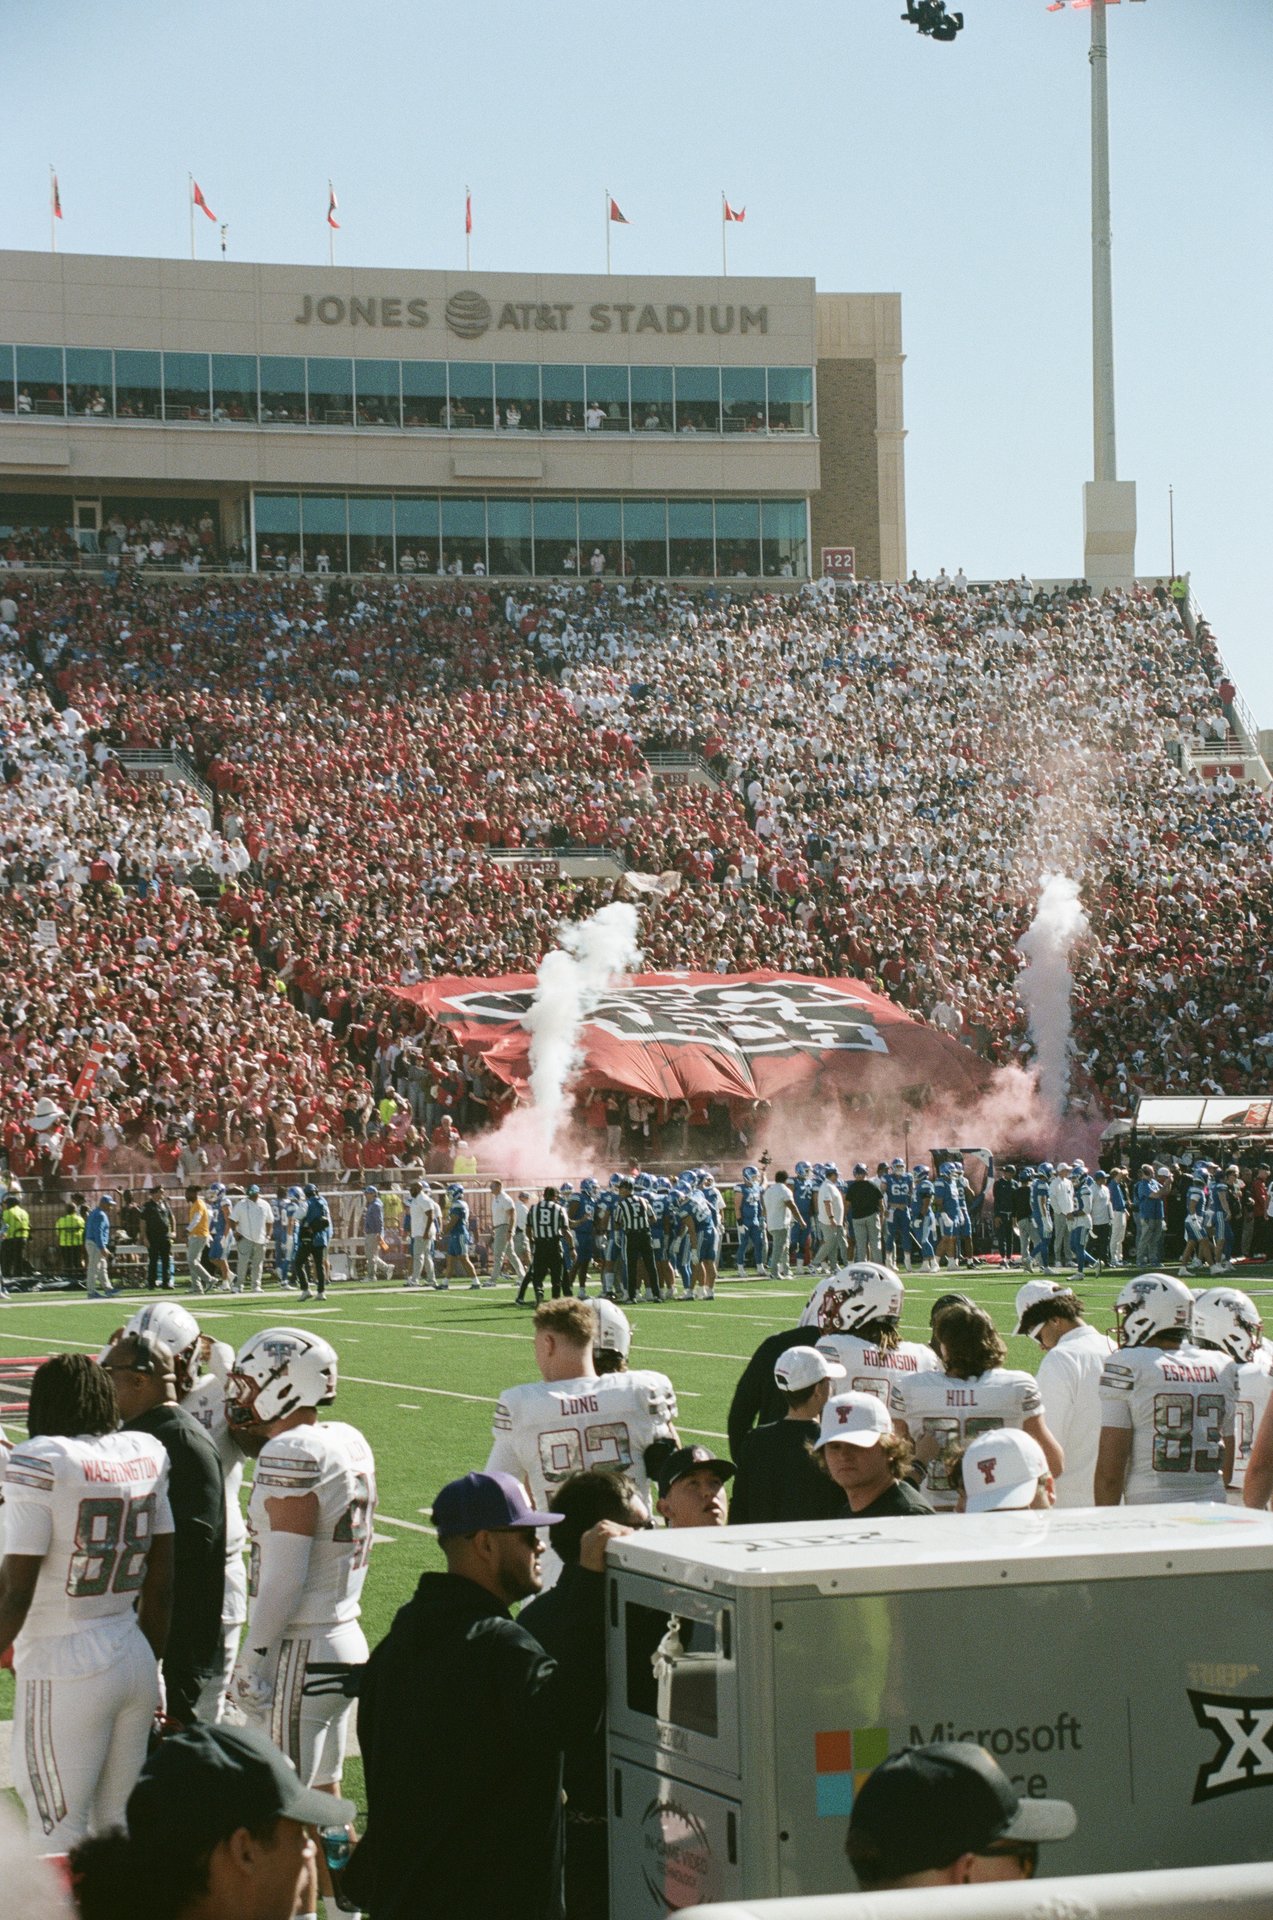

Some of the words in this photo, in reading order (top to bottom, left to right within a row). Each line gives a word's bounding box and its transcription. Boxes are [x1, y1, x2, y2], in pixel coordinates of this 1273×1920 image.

[295, 294, 430, 328] JONES
[497, 303, 574, 331] AT&T
[590, 304, 768, 334] STADIUM
[825, 554, 852, 567] 122
[891, 1184, 909, 1196] 63
[539, 1208, 551, 1225] B
[862, 1349, 918, 1372] ROBINSON
[1161, 1364, 1219, 1383] ESPARZA
[560, 1394, 599, 1416] LONG
[946, 1389, 978, 1407] HILL
[1152, 1393, 1226, 1473] 83
[81, 1456, 160, 1483] WASHINGTON
[65, 1492, 157, 1598] 88
